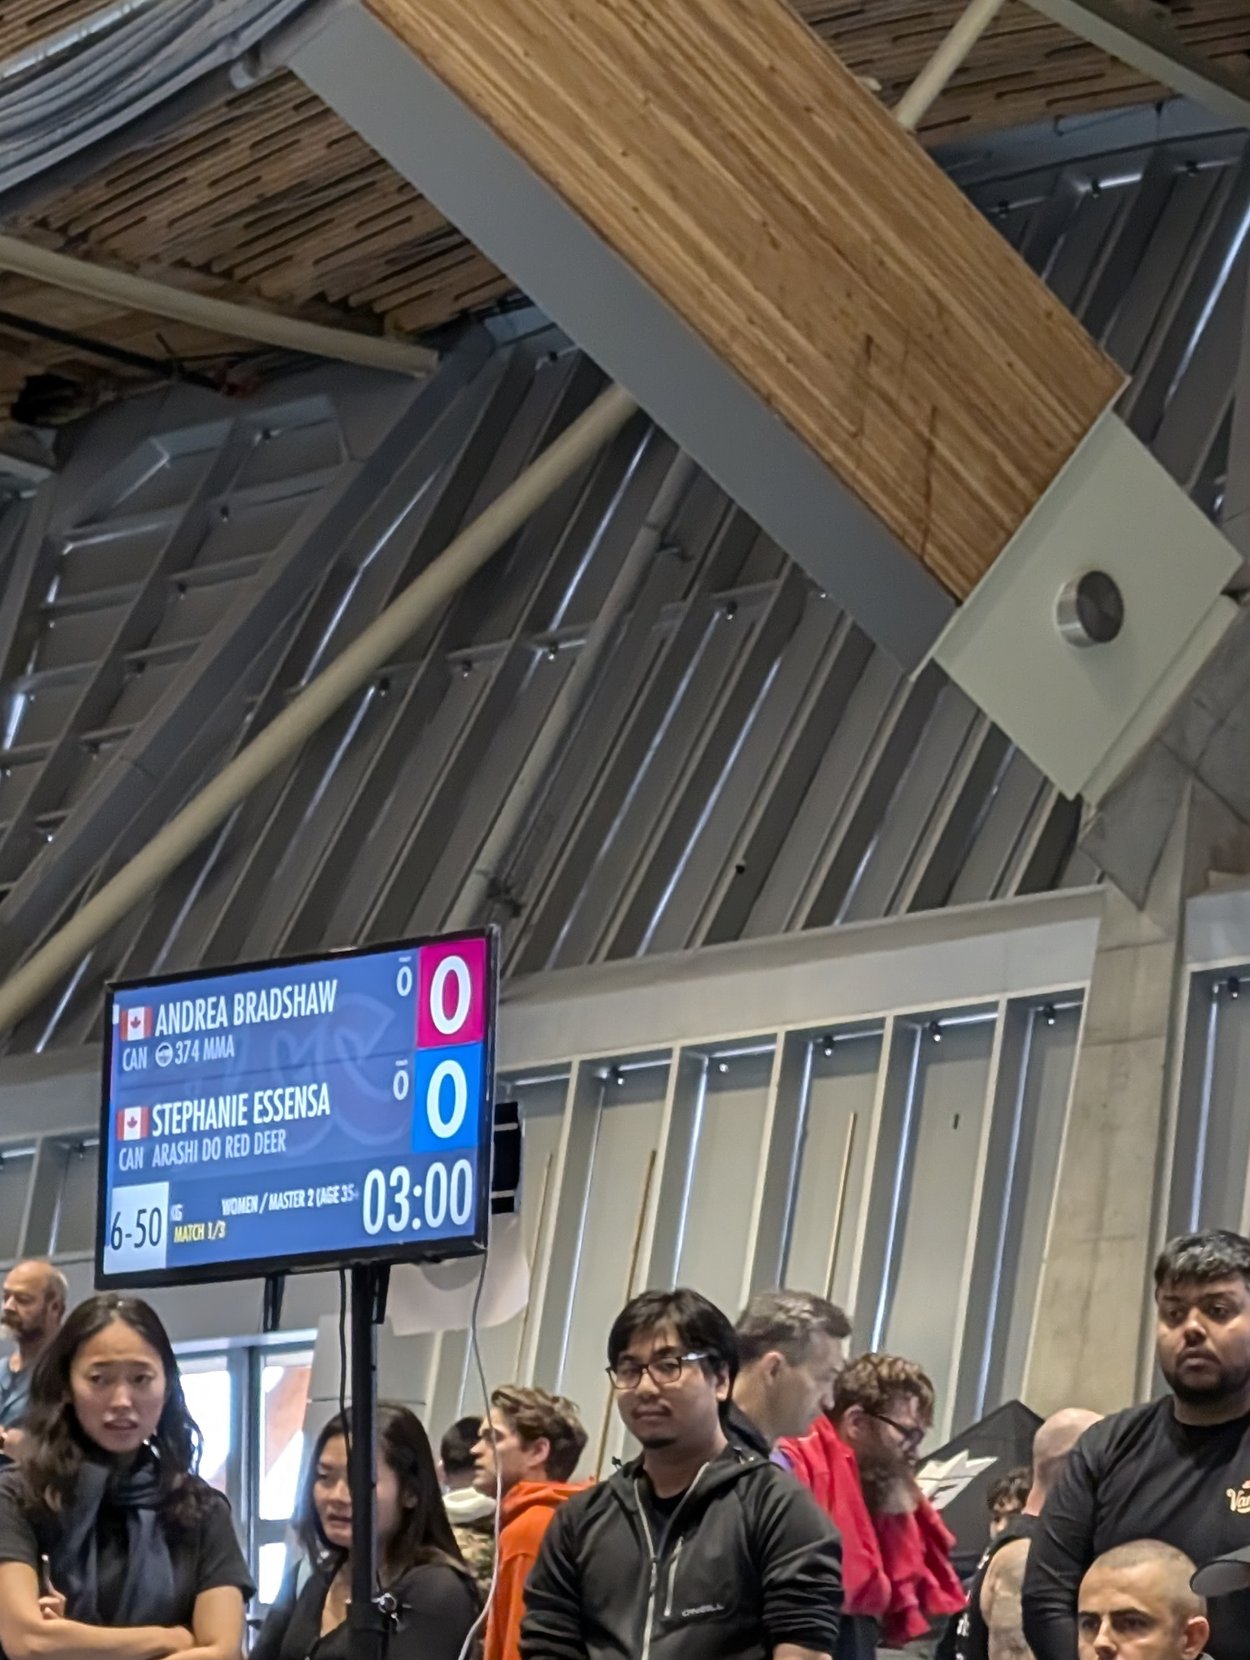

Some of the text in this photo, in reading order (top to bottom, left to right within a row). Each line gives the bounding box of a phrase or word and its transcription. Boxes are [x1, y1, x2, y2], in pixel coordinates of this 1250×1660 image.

[397, 966, 413, 997] 0
[430, 955, 472, 1035] 0
[154, 979, 338, 1037] ANDREA BRADSHAW
[122, 1047, 148, 1072] CAN
[175, 1039, 199, 1064] 374
[203, 1034, 235, 1061] MMA
[393, 1069, 409, 1100] 0
[426, 1059, 468, 1138] 0
[152, 1082, 331, 1137] STEPHANIE ESSENSA
[118, 1147, 144, 1171] CAN
[152, 1129, 286, 1168] ARASHI DO RED DEER
[222, 1195, 258, 1216] WOMEN
[268, 1189, 305, 1211] MASTER
[307, 1188, 315, 1207] 2
[363, 1159, 473, 1235] 03:00
[110, 1207, 162, 1251] 6-50
[174, 1220, 226, 1243] MATCH 1/3
